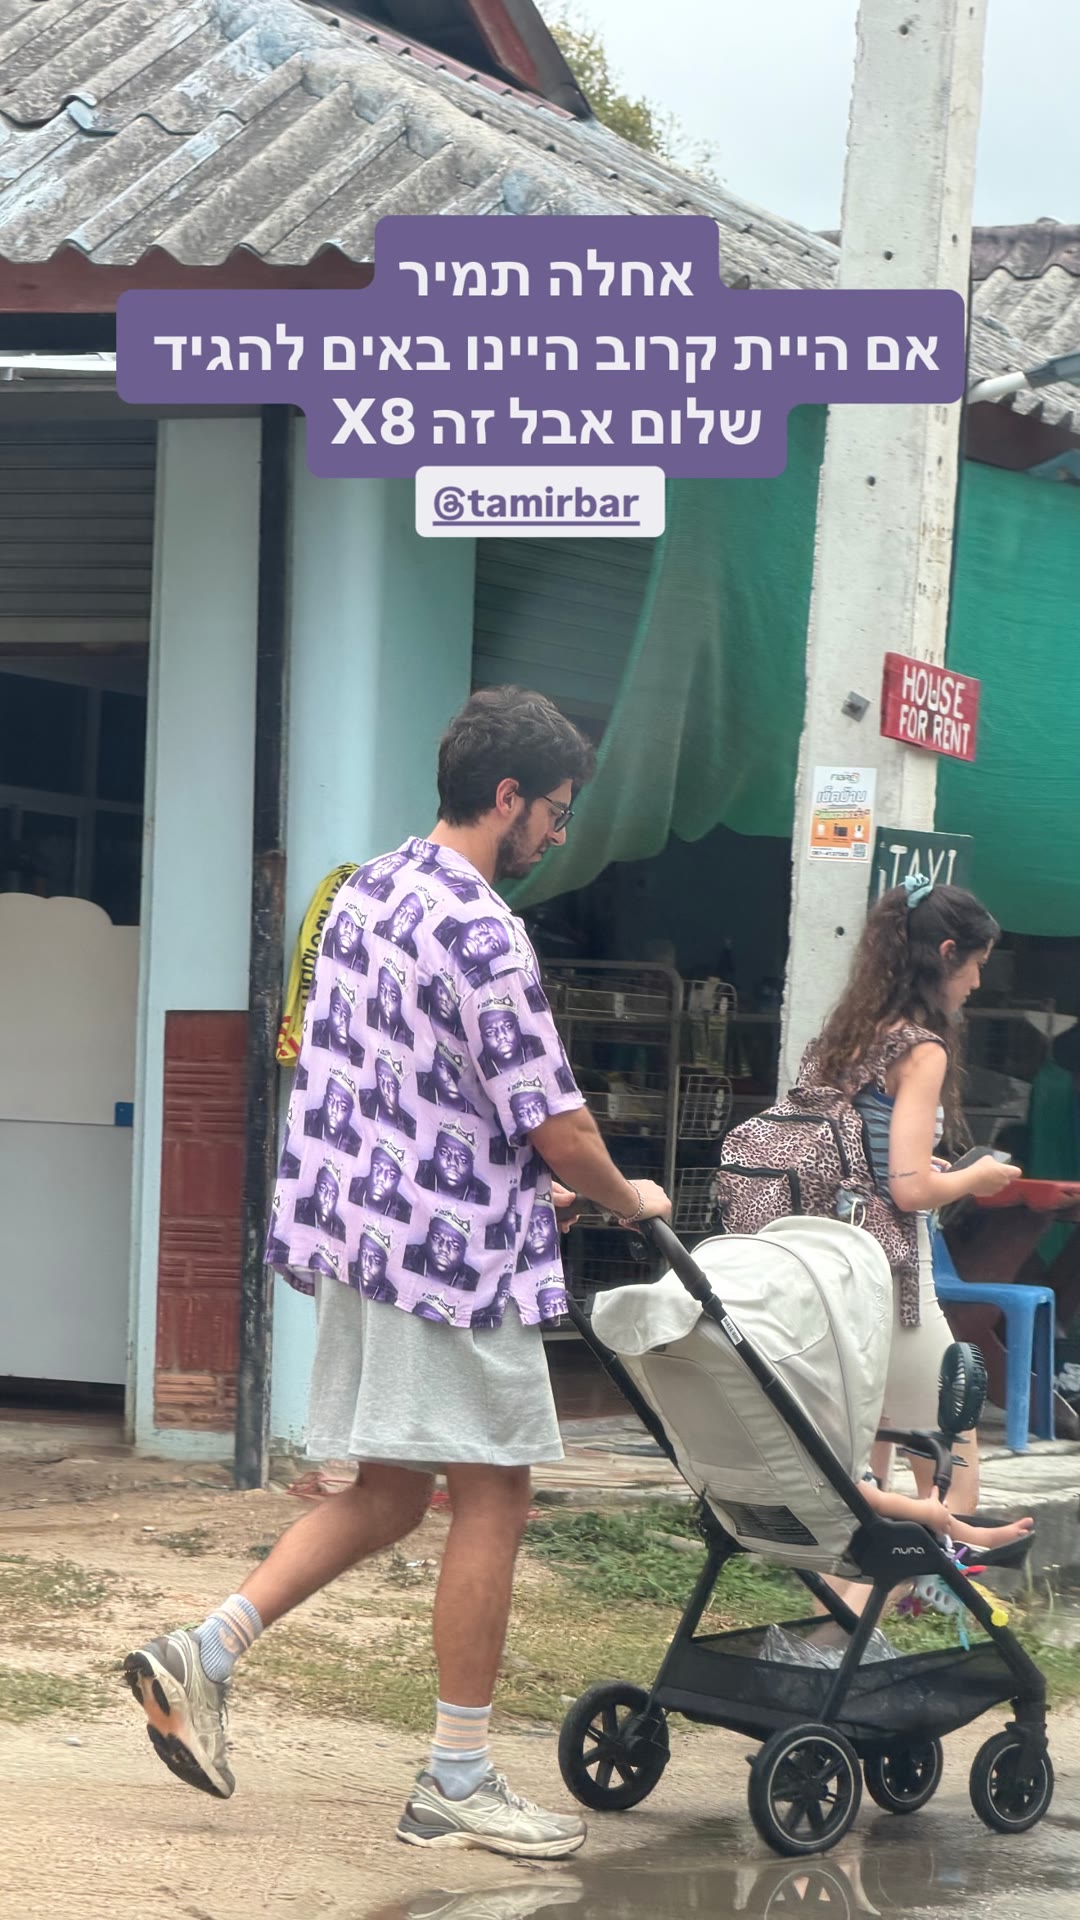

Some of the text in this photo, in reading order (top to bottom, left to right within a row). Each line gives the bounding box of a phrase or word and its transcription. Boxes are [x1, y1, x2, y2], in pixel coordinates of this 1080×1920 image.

[902, 664, 966, 720] HOUSE
[899, 703, 971, 755] FOR RENT
[892, 1546, 925, 1555] nuna
